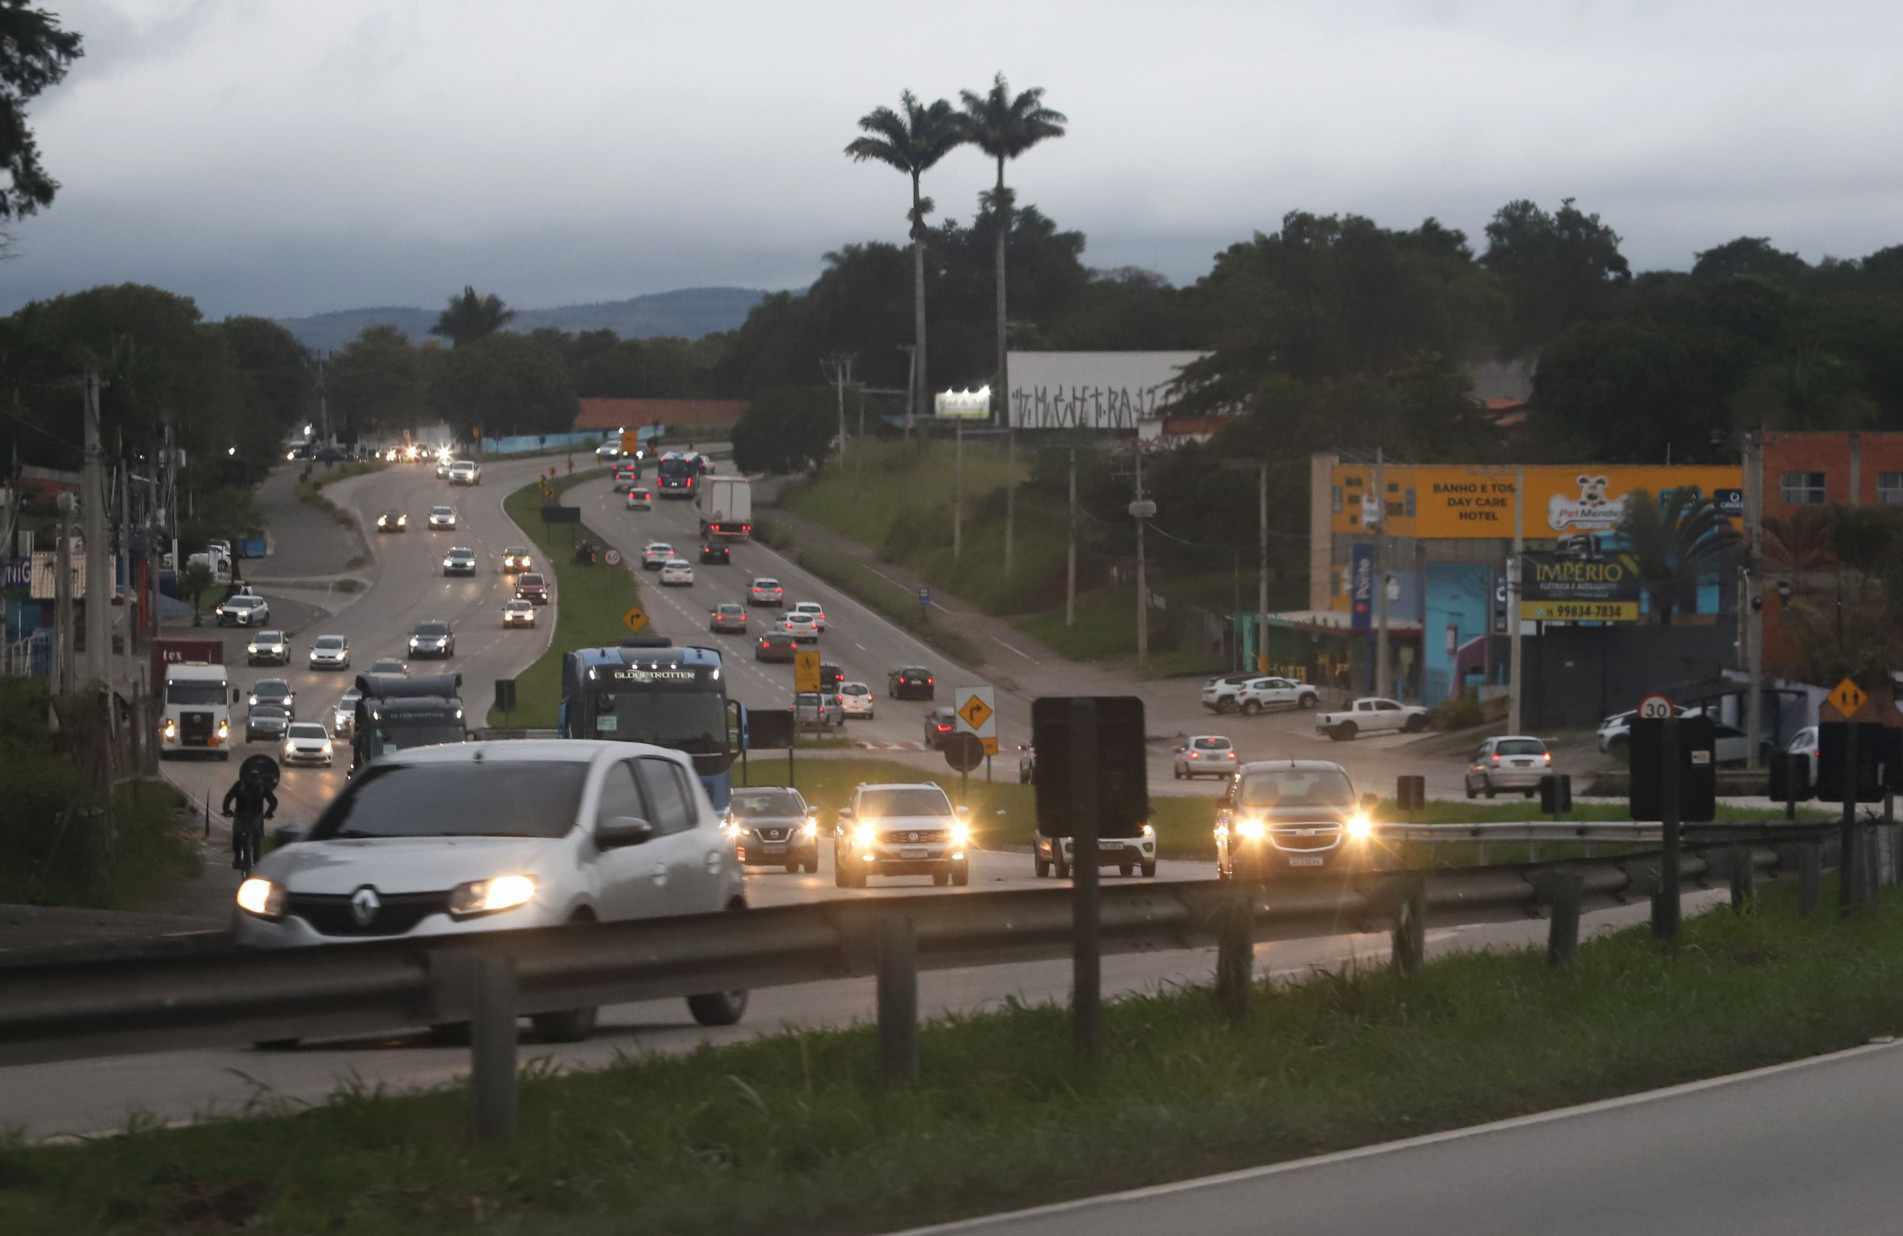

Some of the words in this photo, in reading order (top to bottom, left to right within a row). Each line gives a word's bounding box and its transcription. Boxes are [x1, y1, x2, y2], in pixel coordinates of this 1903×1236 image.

[1433, 483, 1477, 493] BANHO
[1481, 483, 1488, 493] E
[1491, 483, 1516, 493] TOS
[1447, 497, 1472, 507] DAY
[1475, 497, 1507, 507] CARE
[1459, 511, 1499, 521] HOTEL
[1646, 703, 1666, 717] 30
